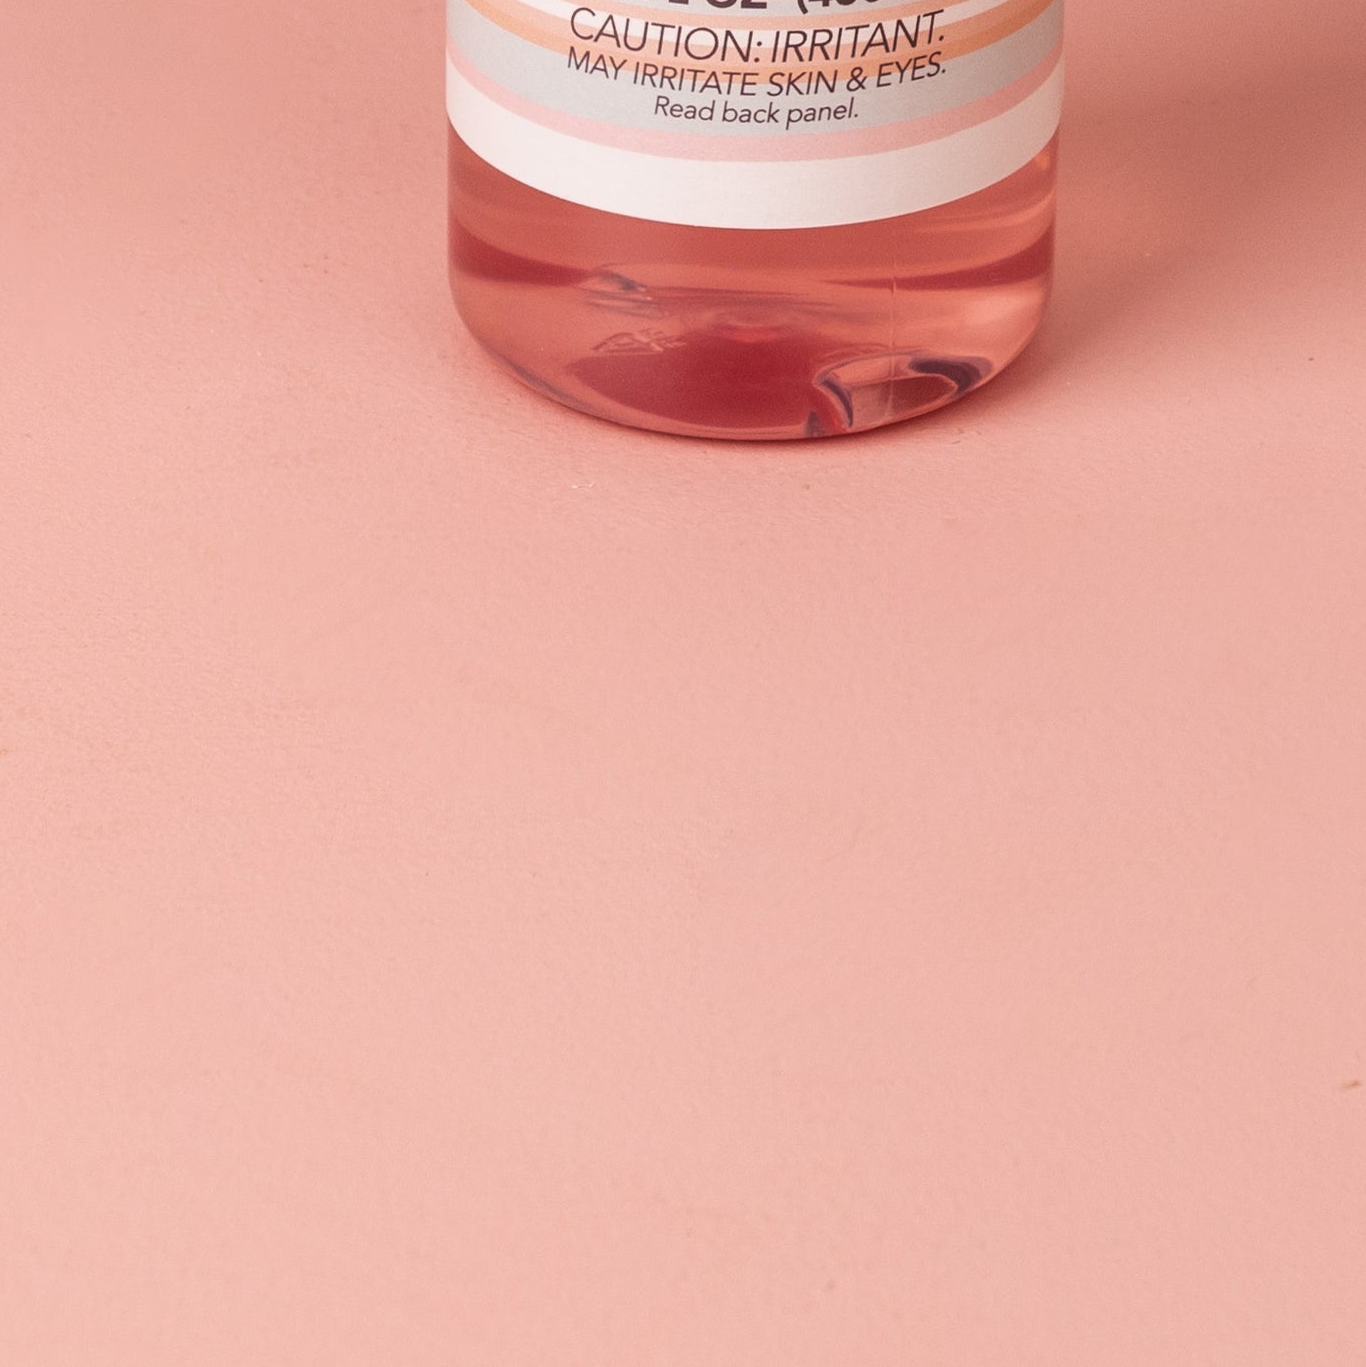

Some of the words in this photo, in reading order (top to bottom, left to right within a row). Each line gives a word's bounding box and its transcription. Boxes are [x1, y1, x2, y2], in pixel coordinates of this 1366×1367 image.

[570, 7, 762, 63] CAUTION:
[771, 10, 945, 63] IRRITANT.
[567, 46, 628, 81] MAY
[632, 61, 758, 97] IRRITATE
[767, 70, 838, 97] SKIN
[846, 68, 866, 92] &
[875, 51, 947, 89] EYES.
[654, 95, 714, 121] Read
[721, 101, 780, 124] back
[785, 97, 859, 130] panel.
